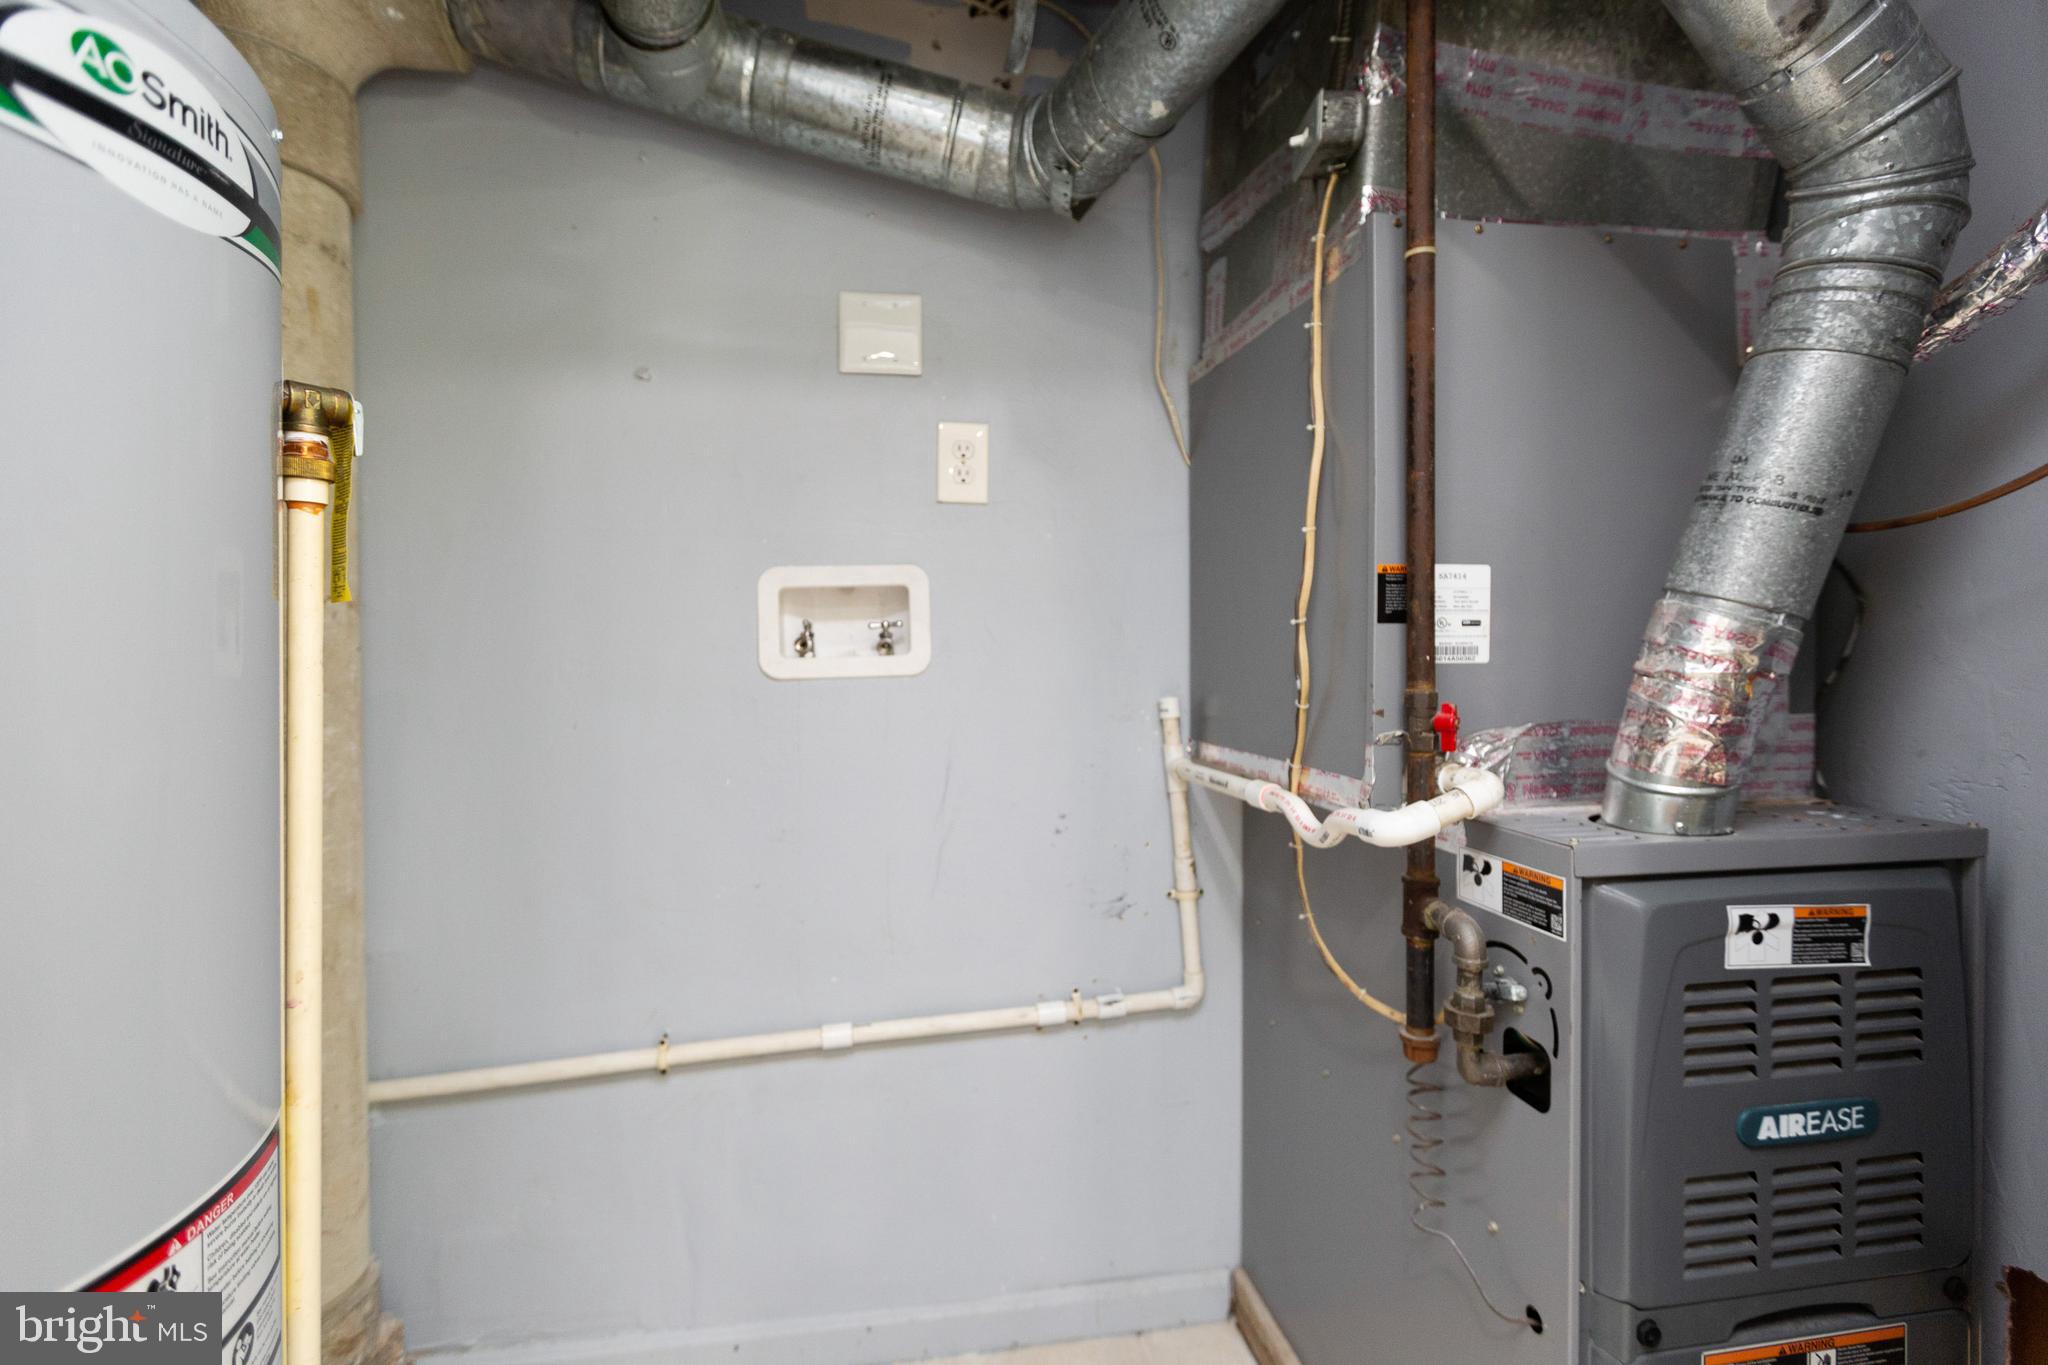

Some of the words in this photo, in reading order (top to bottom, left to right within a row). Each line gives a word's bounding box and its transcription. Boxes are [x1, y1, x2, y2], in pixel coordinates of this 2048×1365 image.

[1757, 1106, 1865, 1140] AIREASE
[186, 1192, 234, 1241] DANGER
[1788, 1338, 1835, 1354] WARNING
